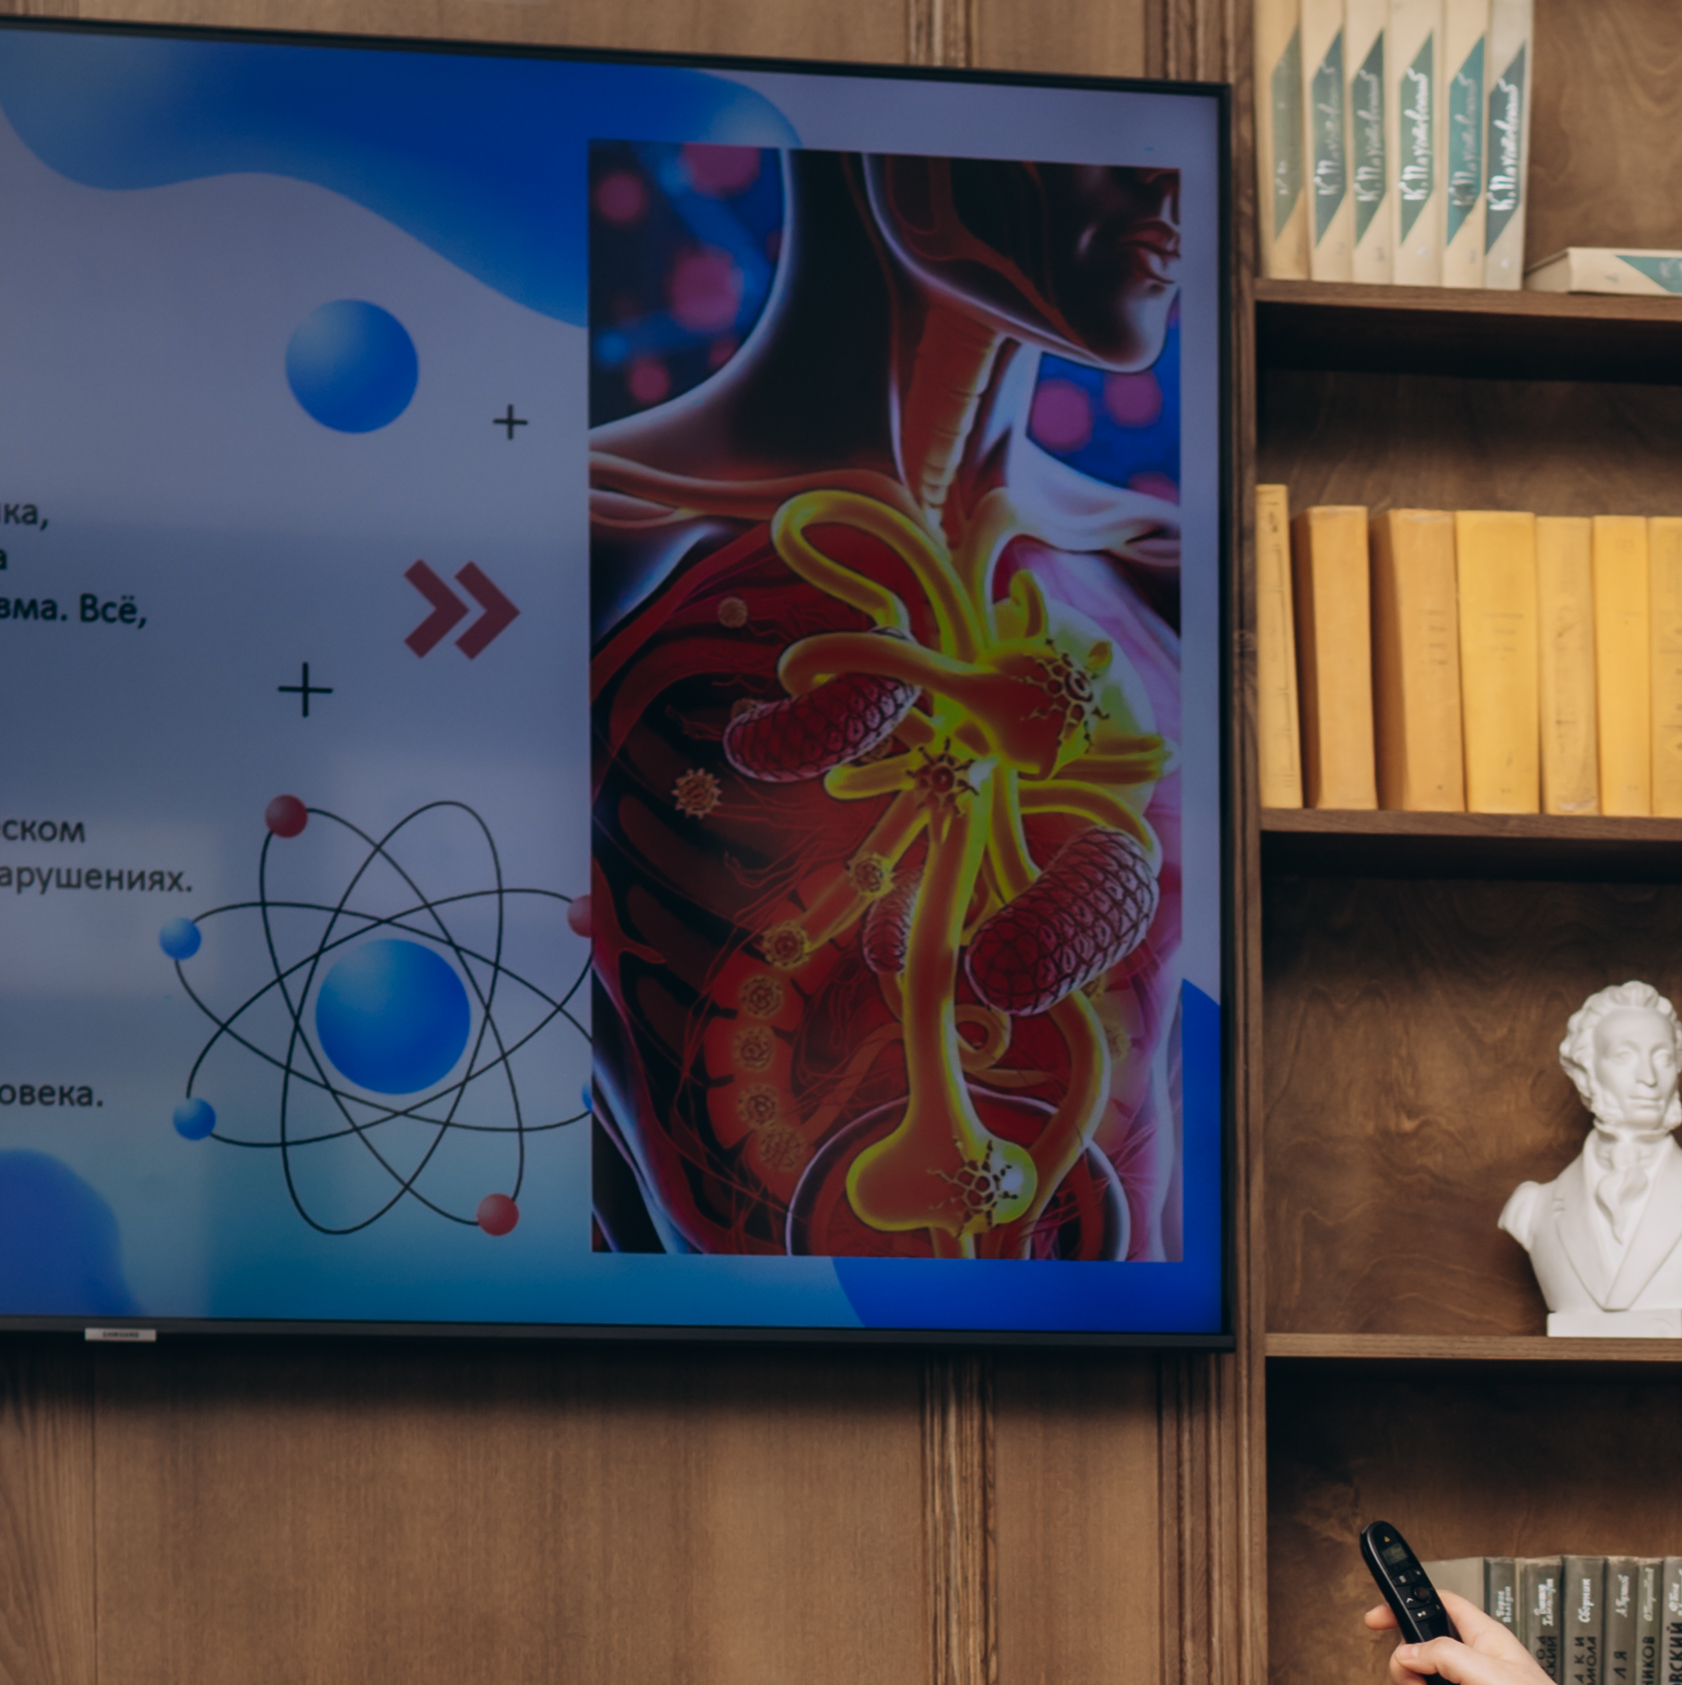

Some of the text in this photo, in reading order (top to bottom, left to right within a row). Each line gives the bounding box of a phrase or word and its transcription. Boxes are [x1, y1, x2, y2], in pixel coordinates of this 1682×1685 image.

[0, 502, 49, 532] ка,
[79, 592, 147, 630] Всё,
[2, 819, 86, 842] ском
[0, 865, 194, 896] арушениях.
[0, 1083, 104, 1107] овека.
